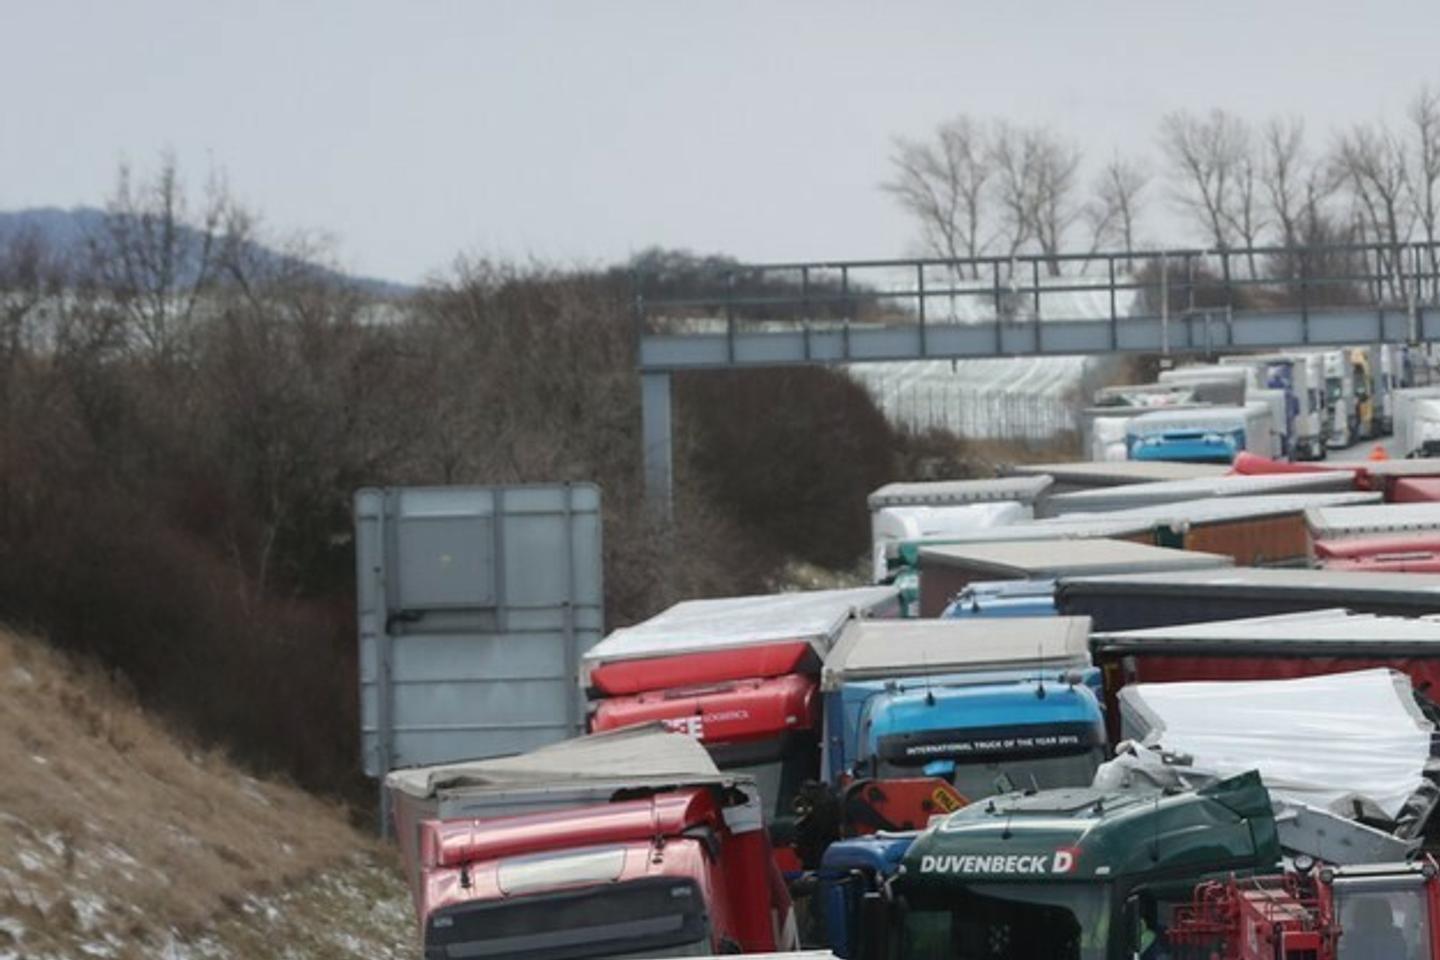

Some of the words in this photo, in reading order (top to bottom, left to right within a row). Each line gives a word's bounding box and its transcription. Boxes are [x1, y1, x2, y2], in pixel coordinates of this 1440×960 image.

[905, 741, 972, 756] INTERNATIONAL
[974, 740, 1001, 750] TRUCK
[1003, 738, 1014, 749] OF
[1017, 737, 1034, 748] THE
[1035, 736, 1057, 747] YEAR
[920, 854, 1048, 874] DUVENBECK
